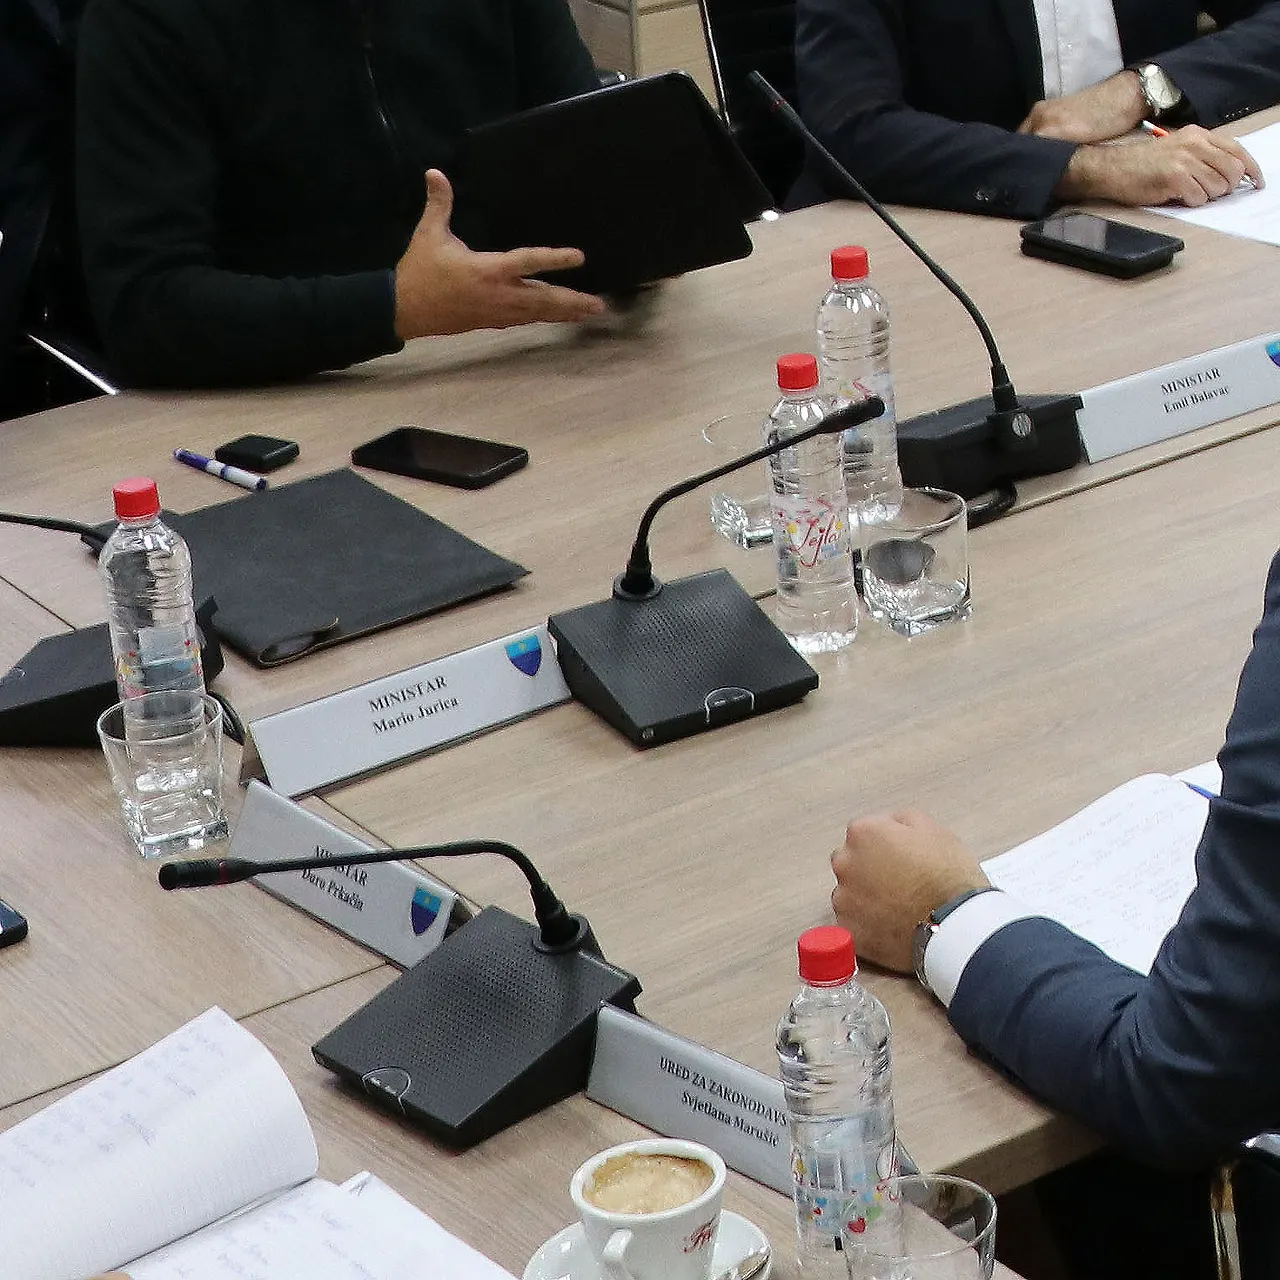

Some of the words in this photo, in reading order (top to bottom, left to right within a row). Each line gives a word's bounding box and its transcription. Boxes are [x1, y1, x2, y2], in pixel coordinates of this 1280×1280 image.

[1161, 368, 1220, 395] MINISTAR
[1164, 397, 1189, 413] Emil
[369, 676, 447, 712] MINISTAR
[373, 711, 414, 734] Mario
[418, 697, 459, 719] Jurica
[660, 1055, 690, 1080] URED
[692, 1073, 706, 1090] ZA
[709, 1079, 787, 1127] ZAKONODAVS
[682, 1091, 731, 1125] Svjetlana
